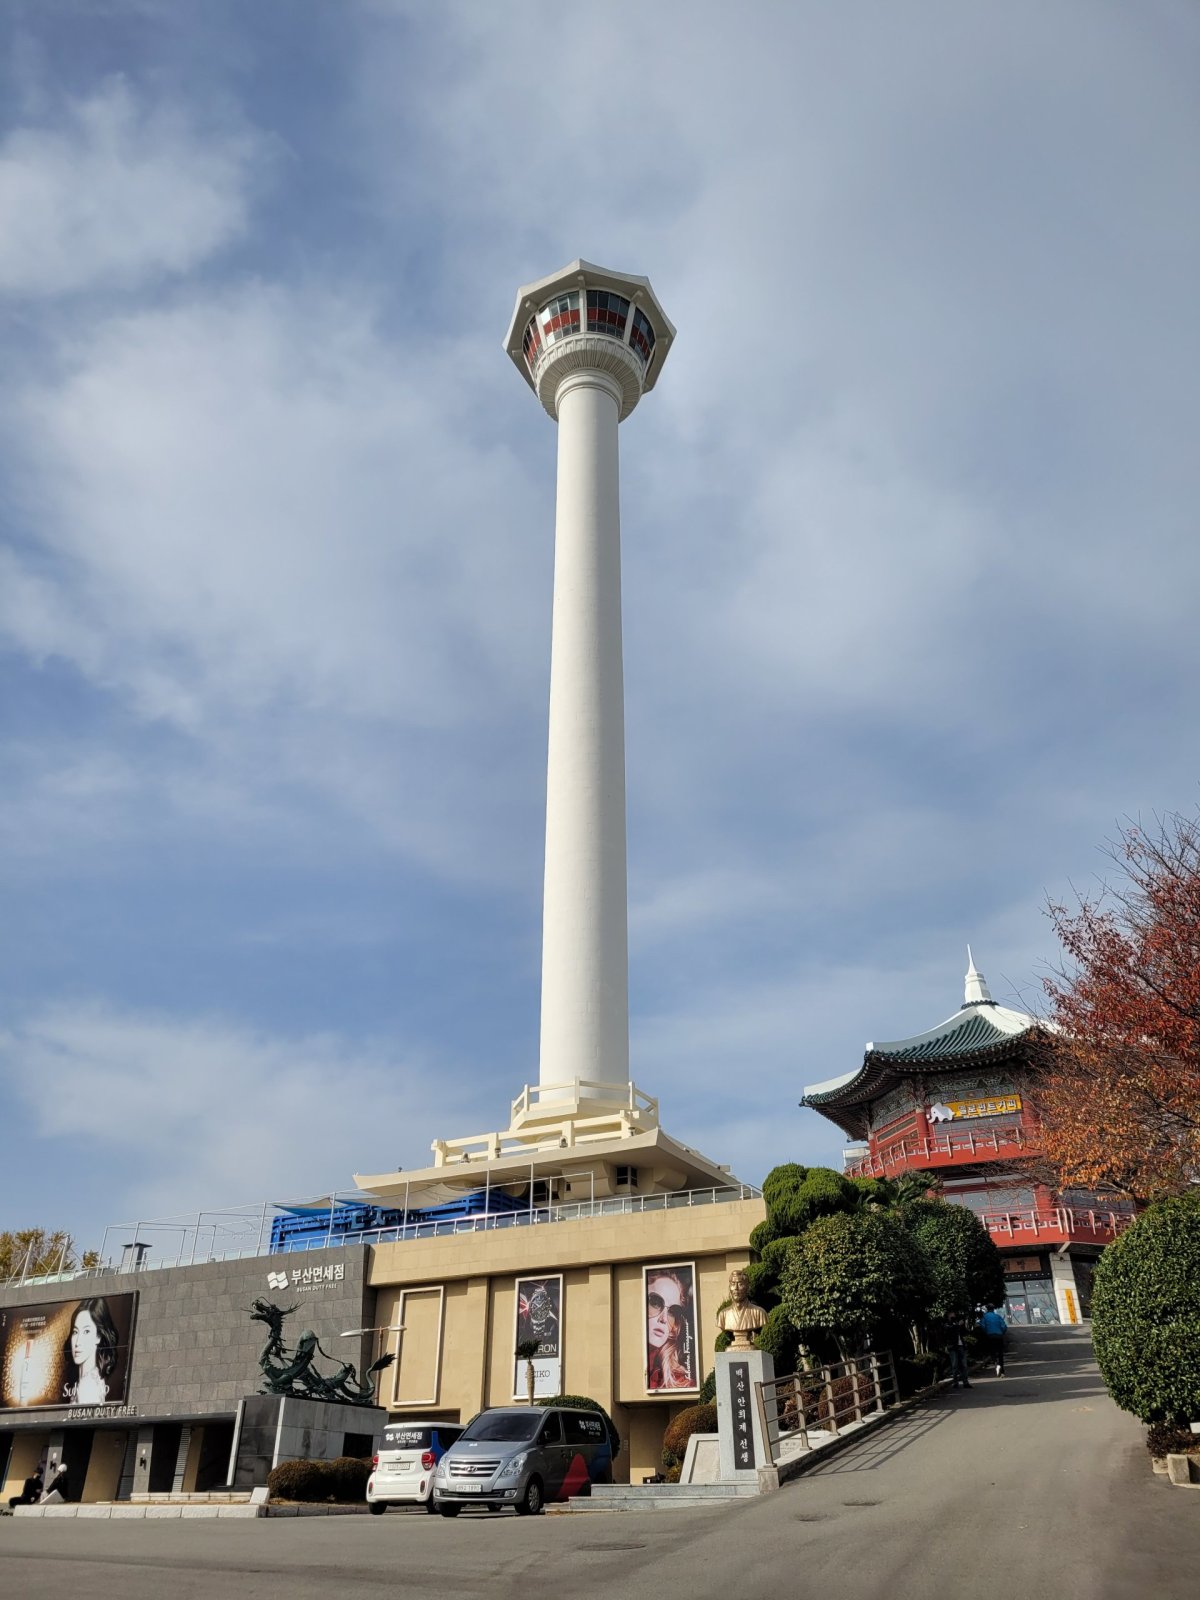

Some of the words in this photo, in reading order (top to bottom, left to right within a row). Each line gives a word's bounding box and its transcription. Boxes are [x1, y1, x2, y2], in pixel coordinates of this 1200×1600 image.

[291, 1264, 345, 1285] 부산면세점
[68, 1407, 92, 1418] BUSAN
[94, 1406, 116, 1417] DUTY
[117, 1405, 136, 1415] FREE
[395, 1431, 423, 1440] 부산면세점
[740, 1438, 749, 1463] 선생
